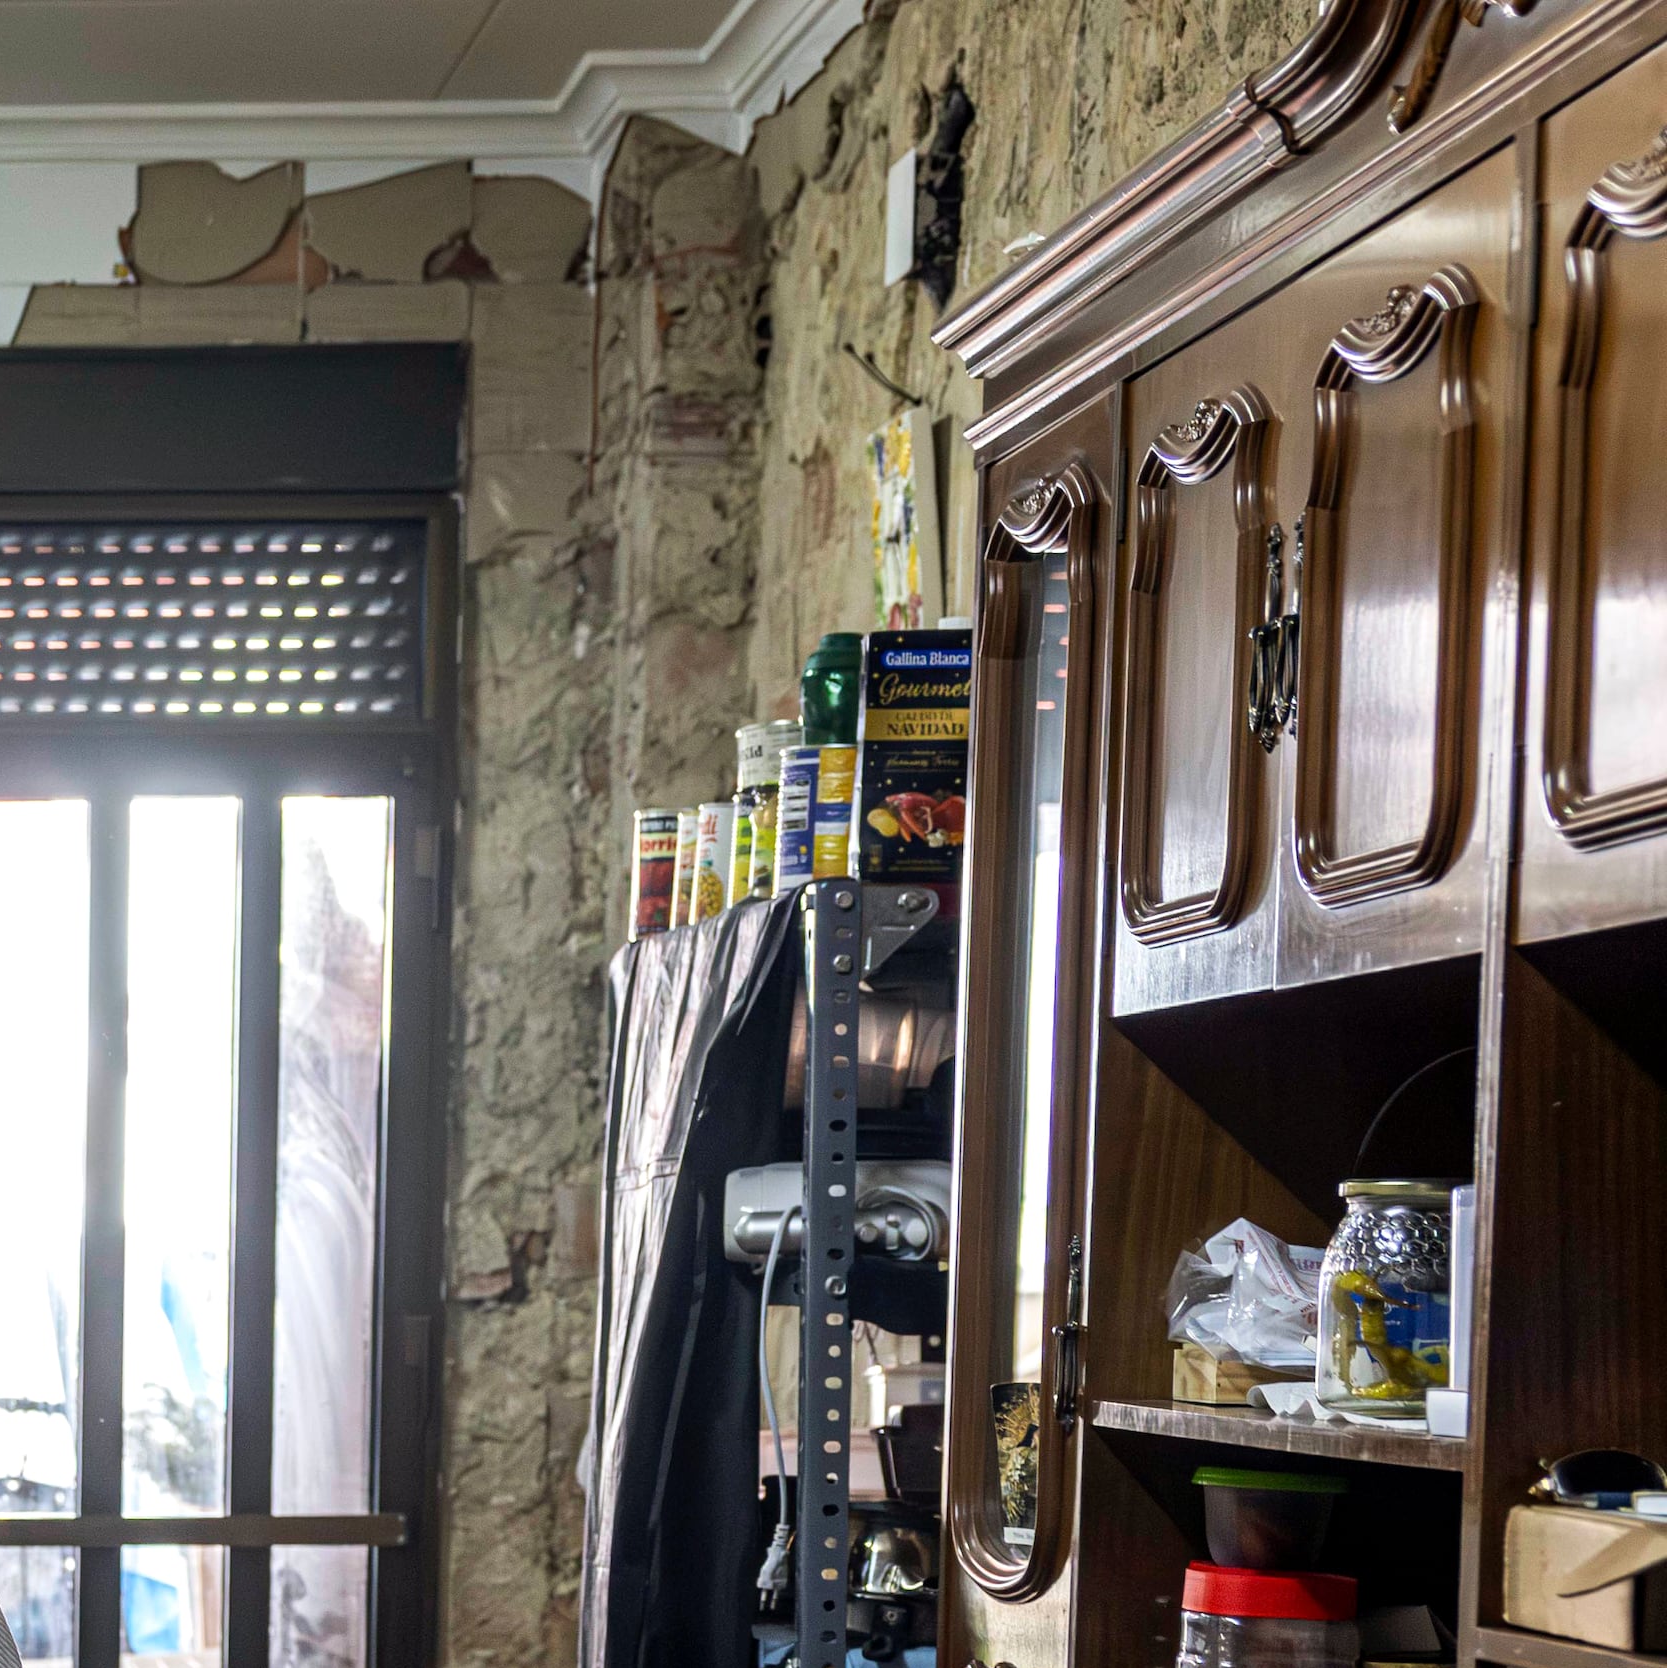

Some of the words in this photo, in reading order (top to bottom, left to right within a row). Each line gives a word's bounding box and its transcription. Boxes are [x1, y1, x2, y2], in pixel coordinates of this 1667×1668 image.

[886, 651, 927, 666] Gallina
[929, 651, 970, 666] Blanca
[879, 673, 971, 705] Gourmet
[887, 722, 965, 737] NAVIDAD
